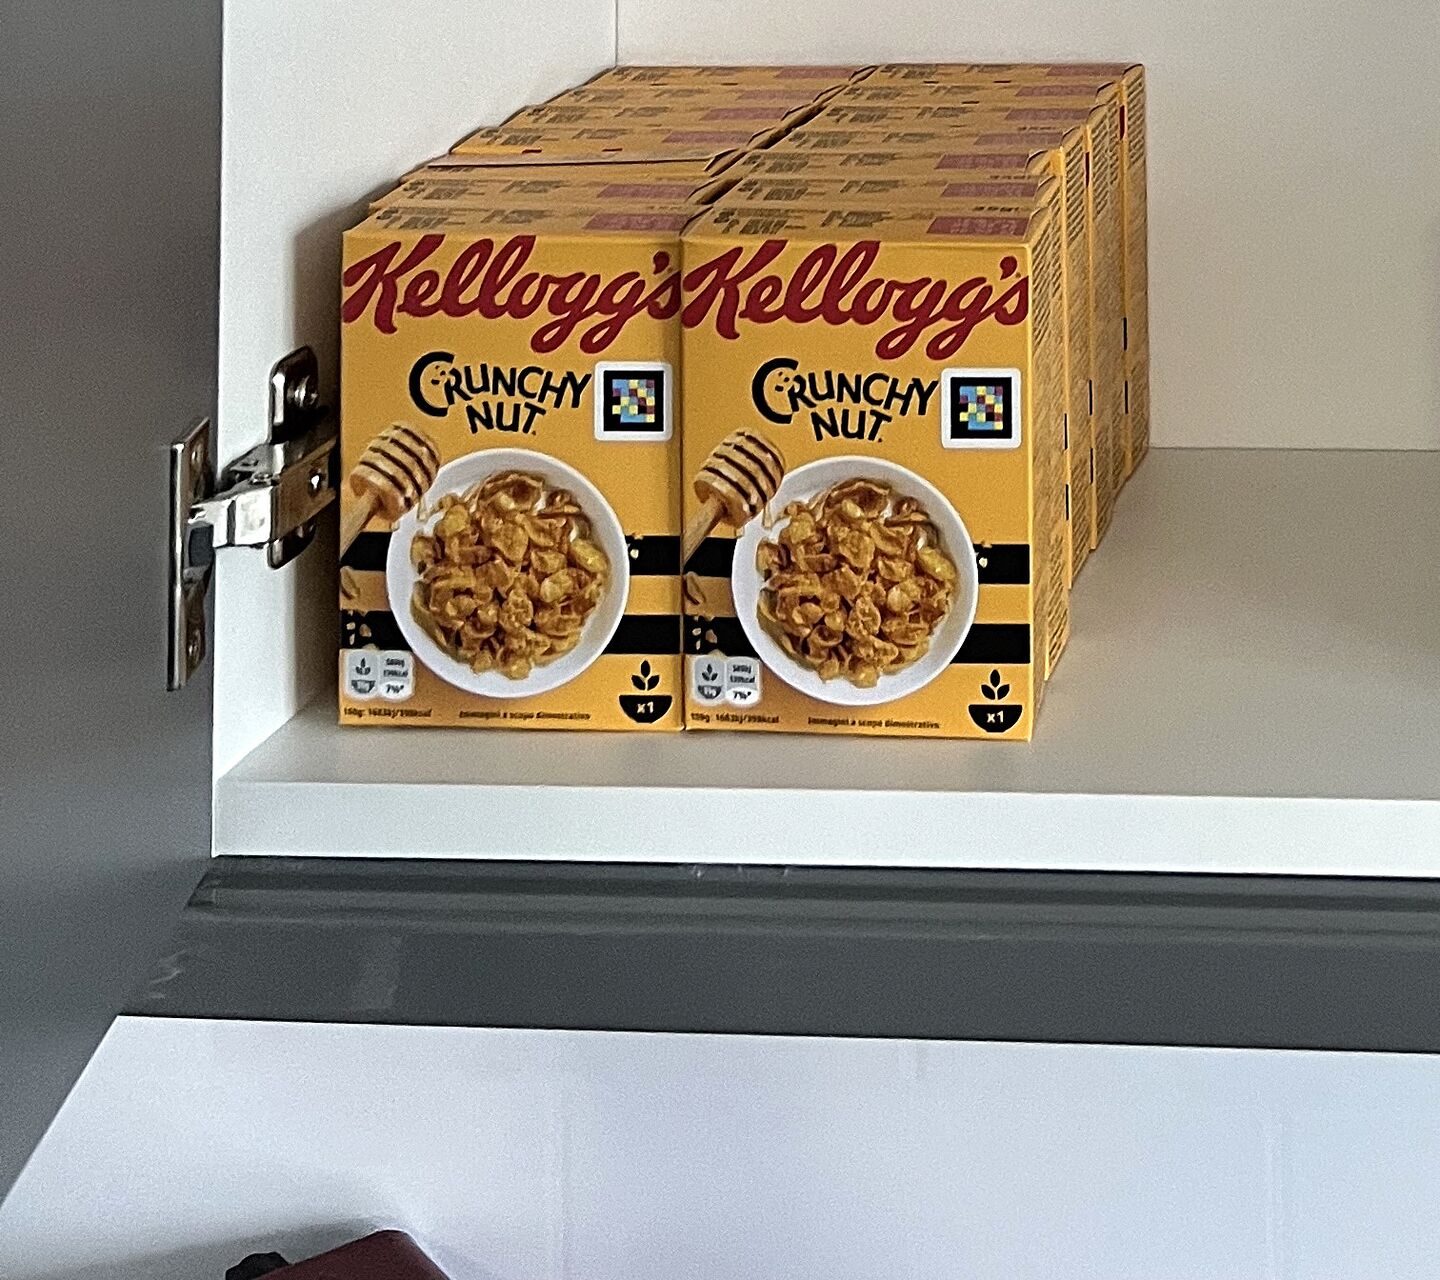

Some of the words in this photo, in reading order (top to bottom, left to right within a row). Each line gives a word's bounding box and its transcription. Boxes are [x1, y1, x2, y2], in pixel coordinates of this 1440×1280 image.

[342, 234, 682, 354] Kellogg's
[681, 240, 1029, 360] Kellogg's
[409, 351, 592, 418] CRUNCHY
[752, 357, 938, 424] CRUNCHY
[465, 401, 546, 435] NUT
[811, 408, 892, 442] NUT
[636, 700, 654, 714] x1
[986, 711, 1004, 724] x1
